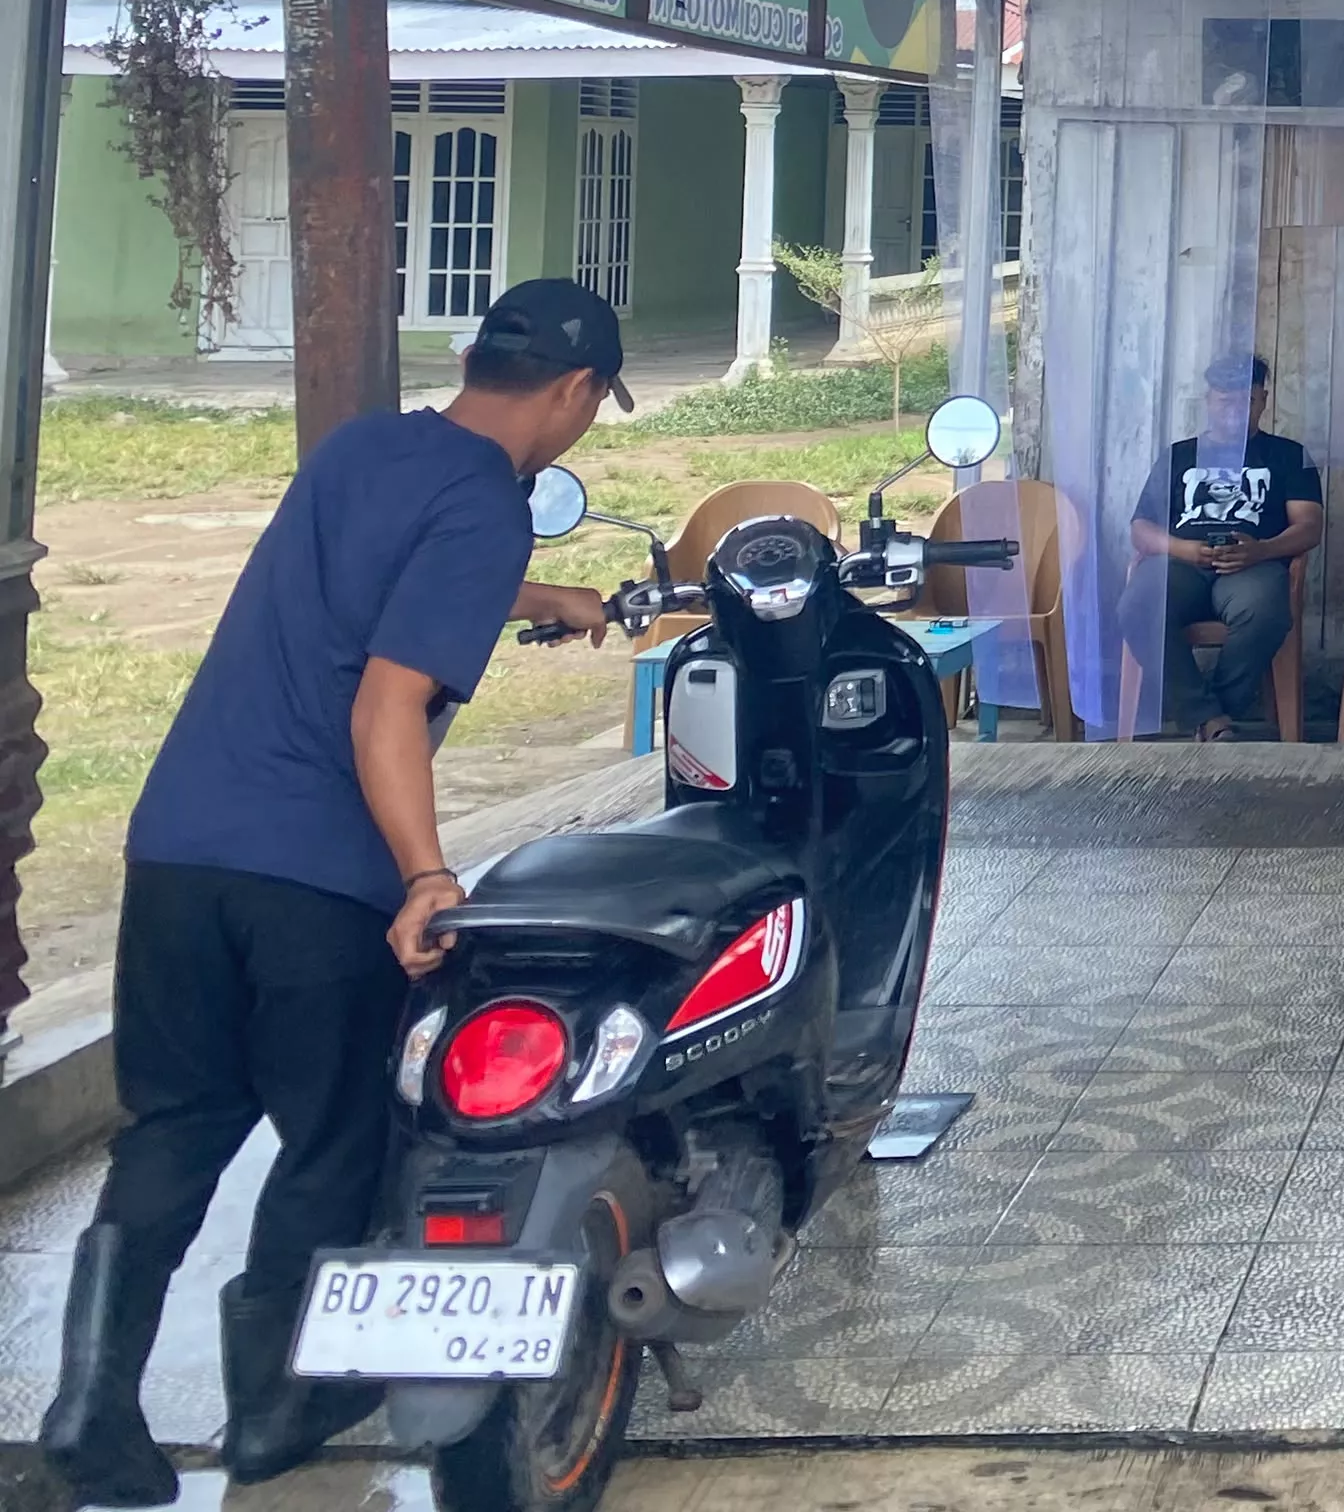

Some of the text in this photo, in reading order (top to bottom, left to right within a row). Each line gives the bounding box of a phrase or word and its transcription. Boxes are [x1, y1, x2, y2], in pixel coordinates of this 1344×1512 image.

[665, 1009, 774, 1072] SCOOPY
[320, 1272, 566, 1318] BD 2920 IN
